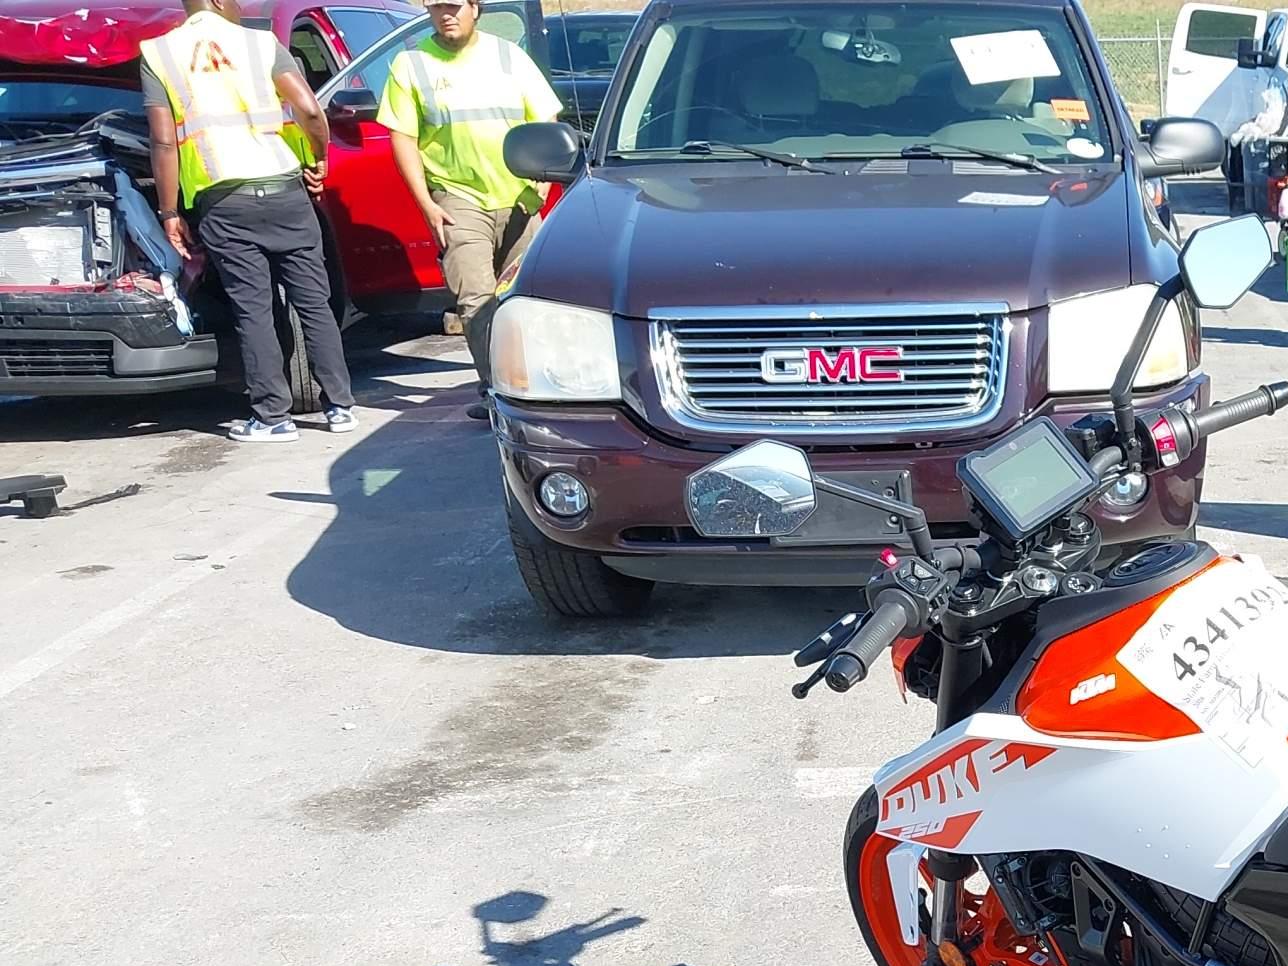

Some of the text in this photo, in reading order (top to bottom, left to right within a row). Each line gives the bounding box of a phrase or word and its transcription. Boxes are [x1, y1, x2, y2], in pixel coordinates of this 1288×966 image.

[761, 347, 905, 383] GMC
[1069, 673, 1116, 705] KTM
[883, 742, 1011, 820] DUKE
